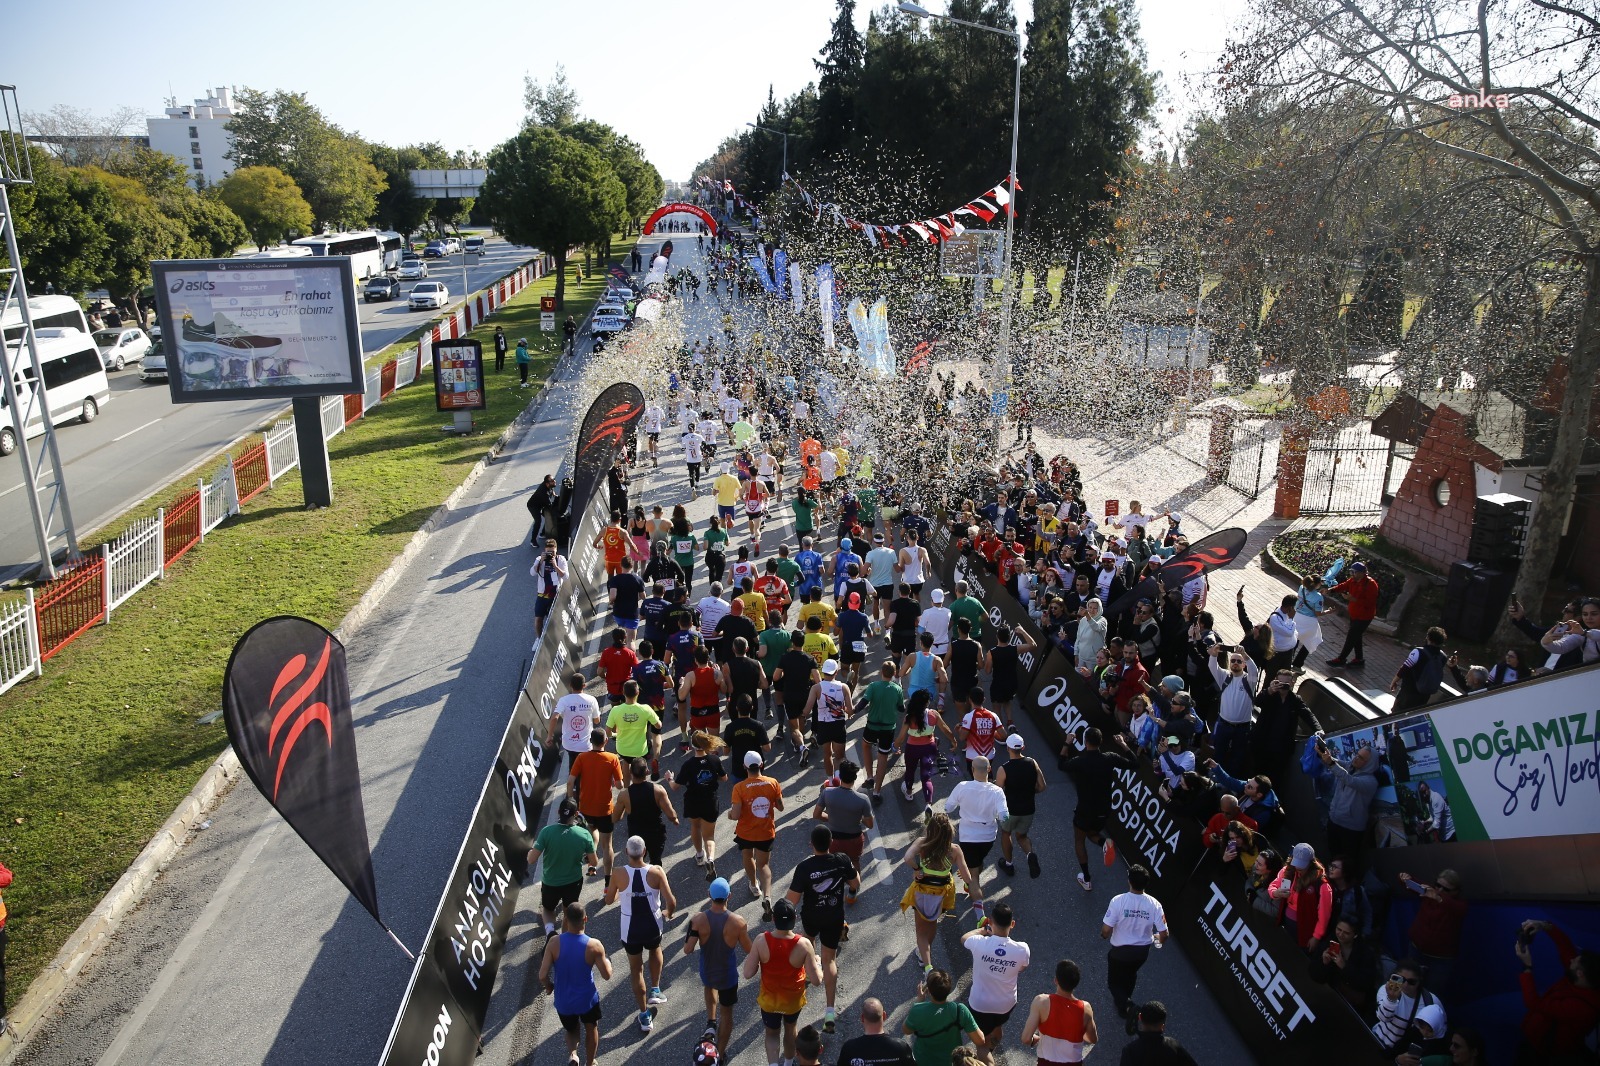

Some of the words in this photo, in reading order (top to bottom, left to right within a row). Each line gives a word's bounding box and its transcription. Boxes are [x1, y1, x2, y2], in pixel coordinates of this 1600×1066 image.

[185, 280, 216, 291] asics
[300, 290, 331, 301] rahat
[516, 727, 544, 799] asics
[1053, 695, 1093, 752] asics
[1111, 781, 1166, 878] OSPITAL
[450, 837, 499, 965] ANATOLIA
[463, 862, 513, 991] HOSPITAL
[1197, 916, 1231, 962] PROJECT
[1229, 962, 1287, 1041] MANAGEMENT
[1203, 881, 1317, 1033] TURSET
